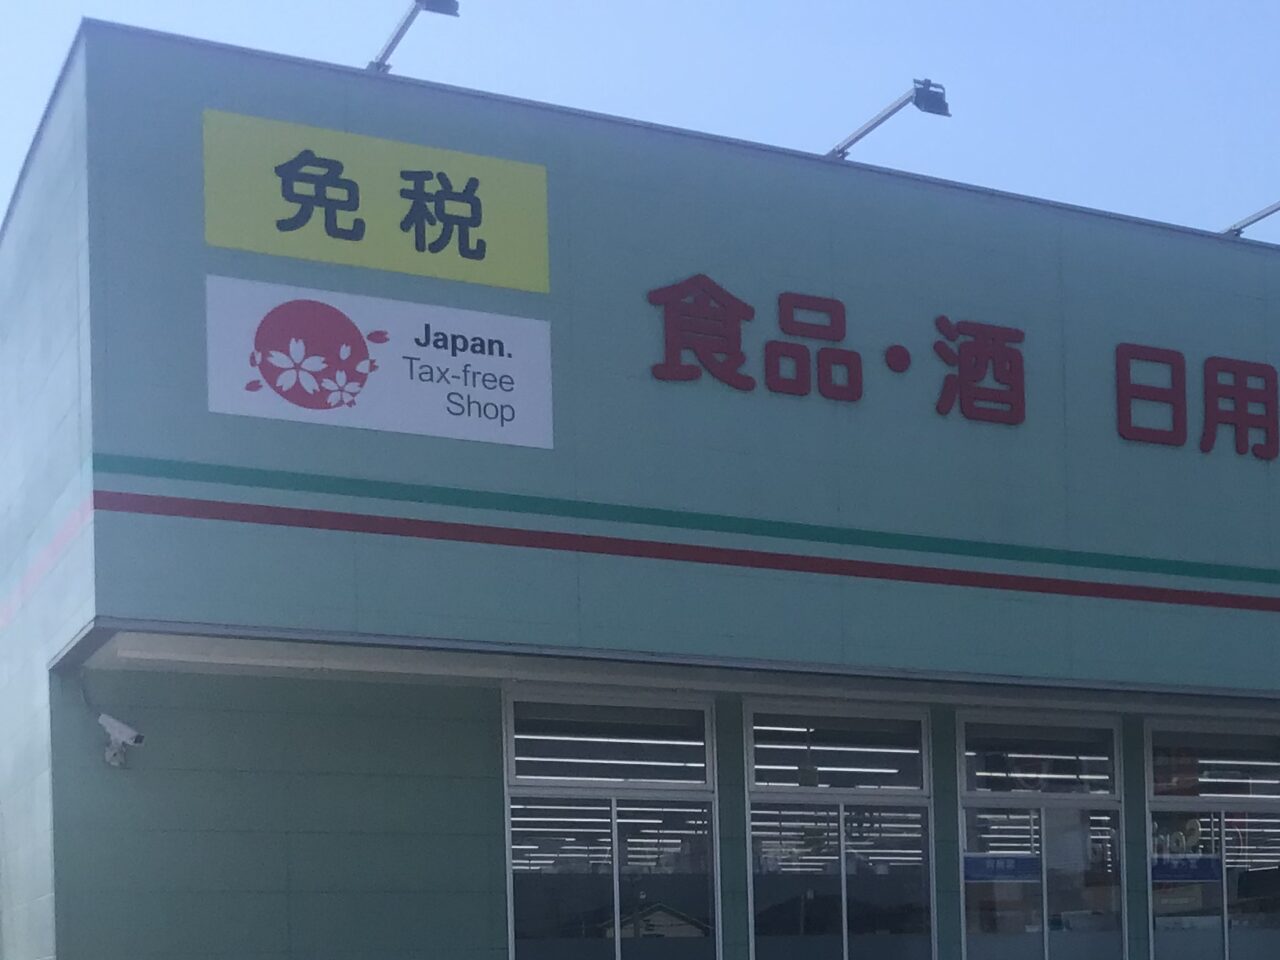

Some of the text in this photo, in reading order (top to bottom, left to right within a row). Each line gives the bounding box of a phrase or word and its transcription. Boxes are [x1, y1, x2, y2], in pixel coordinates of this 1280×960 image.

[274, 149, 486, 261] 免税
[414, 324, 513, 359] Japan.
[647, 273, 1026, 427] 食品・酒
[402, 356, 515, 392] Tax-free
[446, 392, 516, 427] Shop
